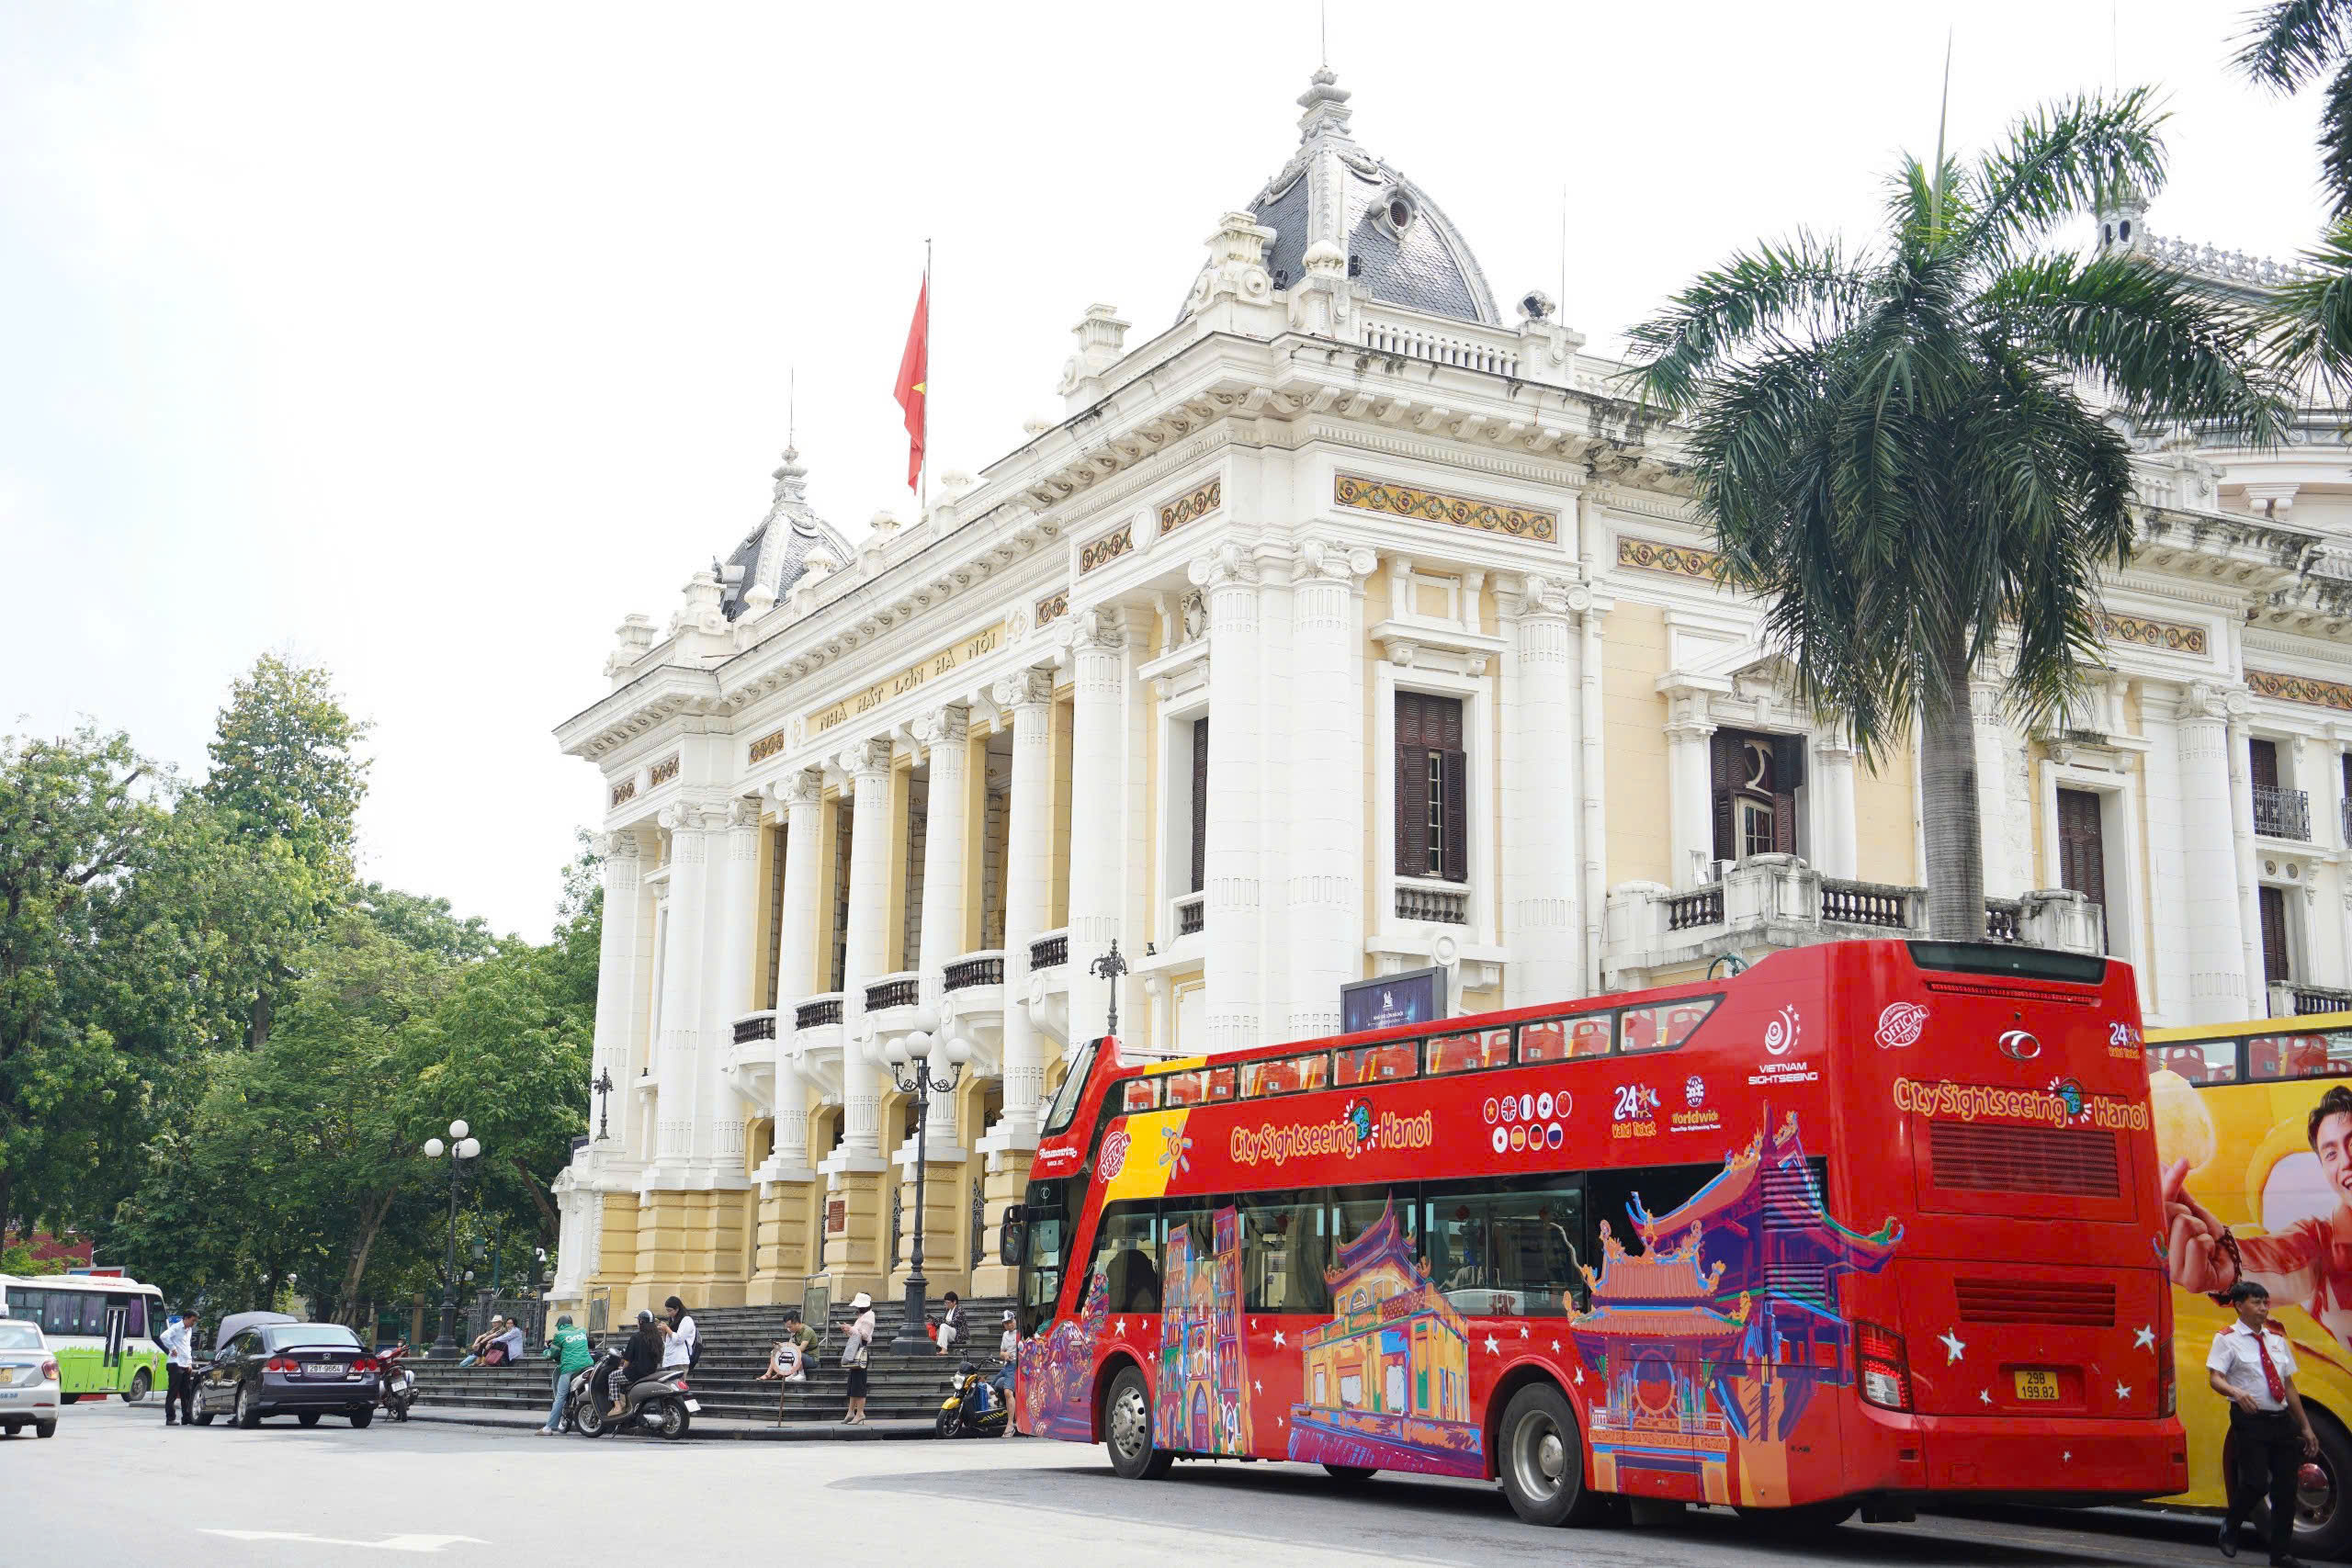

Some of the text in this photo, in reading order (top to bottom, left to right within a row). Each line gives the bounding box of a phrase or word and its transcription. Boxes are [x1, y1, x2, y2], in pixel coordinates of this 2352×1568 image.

[820, 630, 995, 732] NHÀ HÁT LỚN HÀ NỘI
[1882, 1008, 1926, 1043] OFFICIAL
[1900, 1024, 1920, 1043] TOUR
[2109, 1022, 2127, 1046] 24
[1747, 1072, 1818, 1085] SIGHTSEEING
[1758, 1062, 1807, 1074] VIETNAM
[1613, 1083, 1638, 1121] 24
[2093, 1095, 2148, 1130] Hanoi
[1381, 1110, 1432, 1148] Hanoi
[1612, 1121, 1657, 1138] Valid Ticket
[1102, 1135, 1129, 1176] OFFICIAL
[1112, 1156, 1125, 1175] TOUR
[2027, 1371, 2045, 1384] 29B
[2021, 1385, 2055, 1398] 199.82
